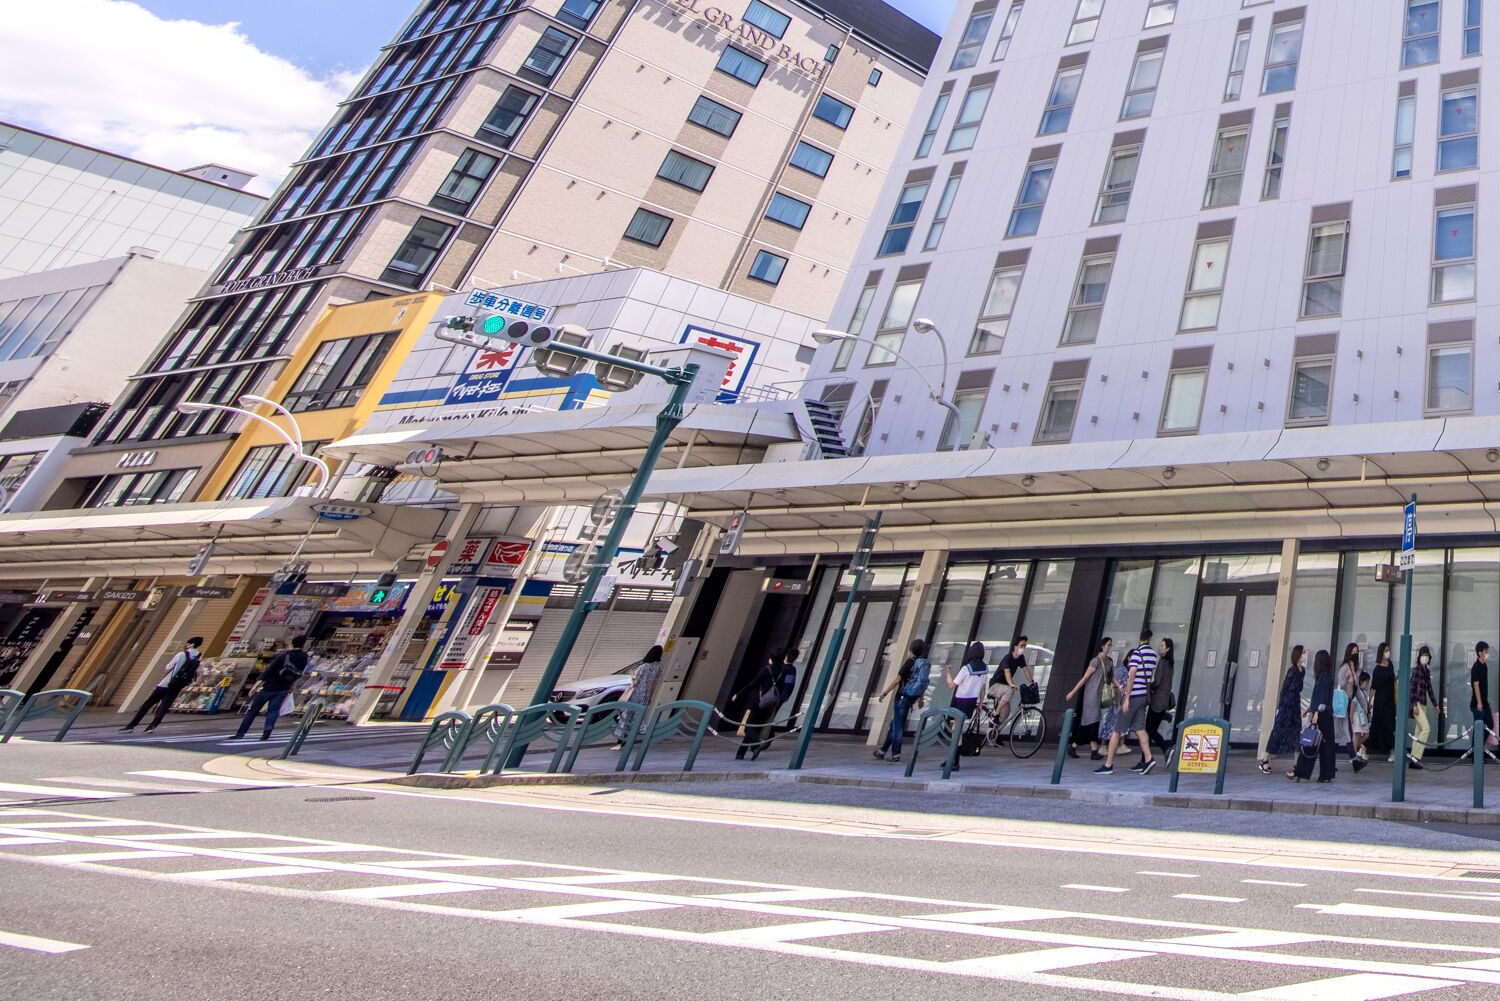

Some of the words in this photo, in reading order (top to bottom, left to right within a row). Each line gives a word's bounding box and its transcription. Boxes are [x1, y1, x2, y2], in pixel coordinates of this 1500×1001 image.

[704, 6, 777, 51] GRAND
[777, 42, 827, 80] BACH
[221, 278, 250, 294] HOTEL
[249, 271, 287, 289] GRAND
[285, 265, 316, 282] BACH
[469, 290, 547, 321] 歩車分離信号
[458, 539, 482, 562] 薬
[103, 591, 136, 600] SAKIZO
